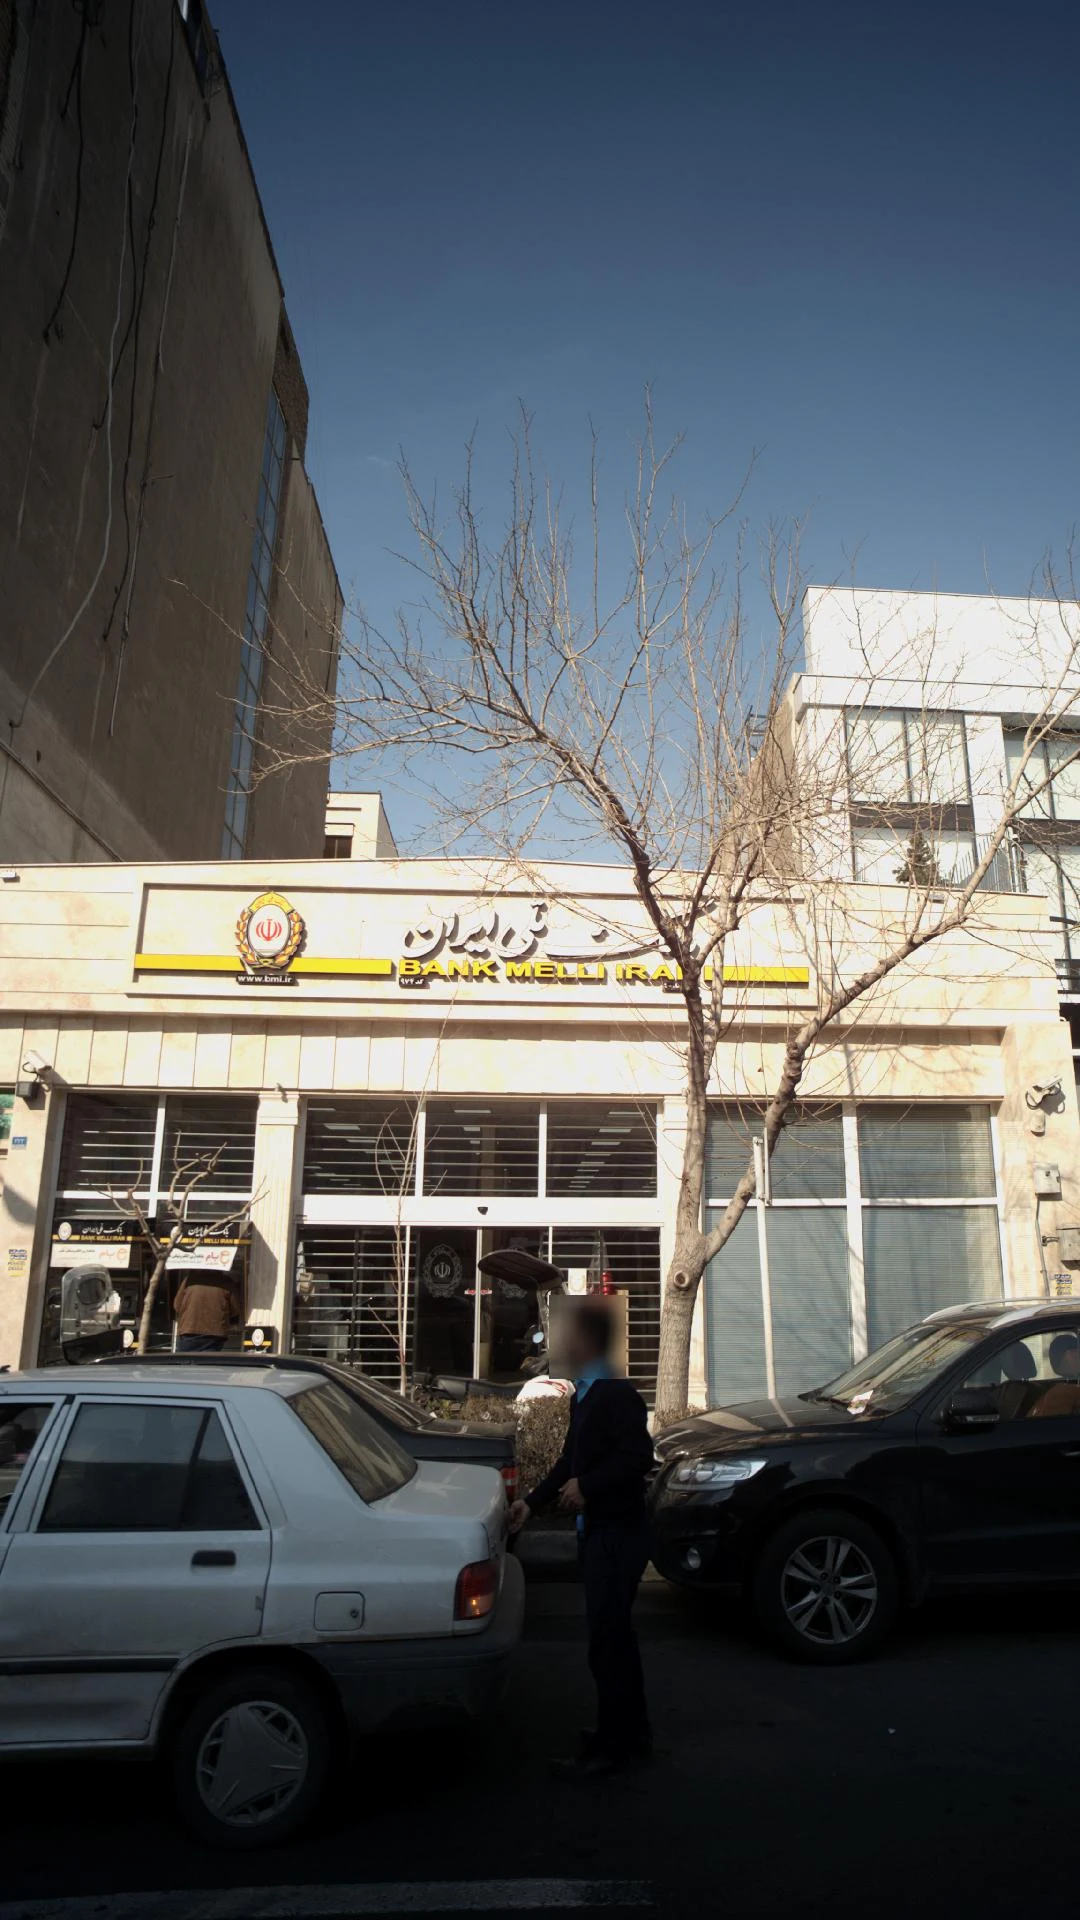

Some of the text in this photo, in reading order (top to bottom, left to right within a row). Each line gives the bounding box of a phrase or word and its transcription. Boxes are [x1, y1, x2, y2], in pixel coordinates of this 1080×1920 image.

[400, 910, 499, 960] ایران
[237, 974, 293, 984] www.bmi.ir
[399, 958, 496, 977] BANK
[506, 961, 605, 979] MELLI
